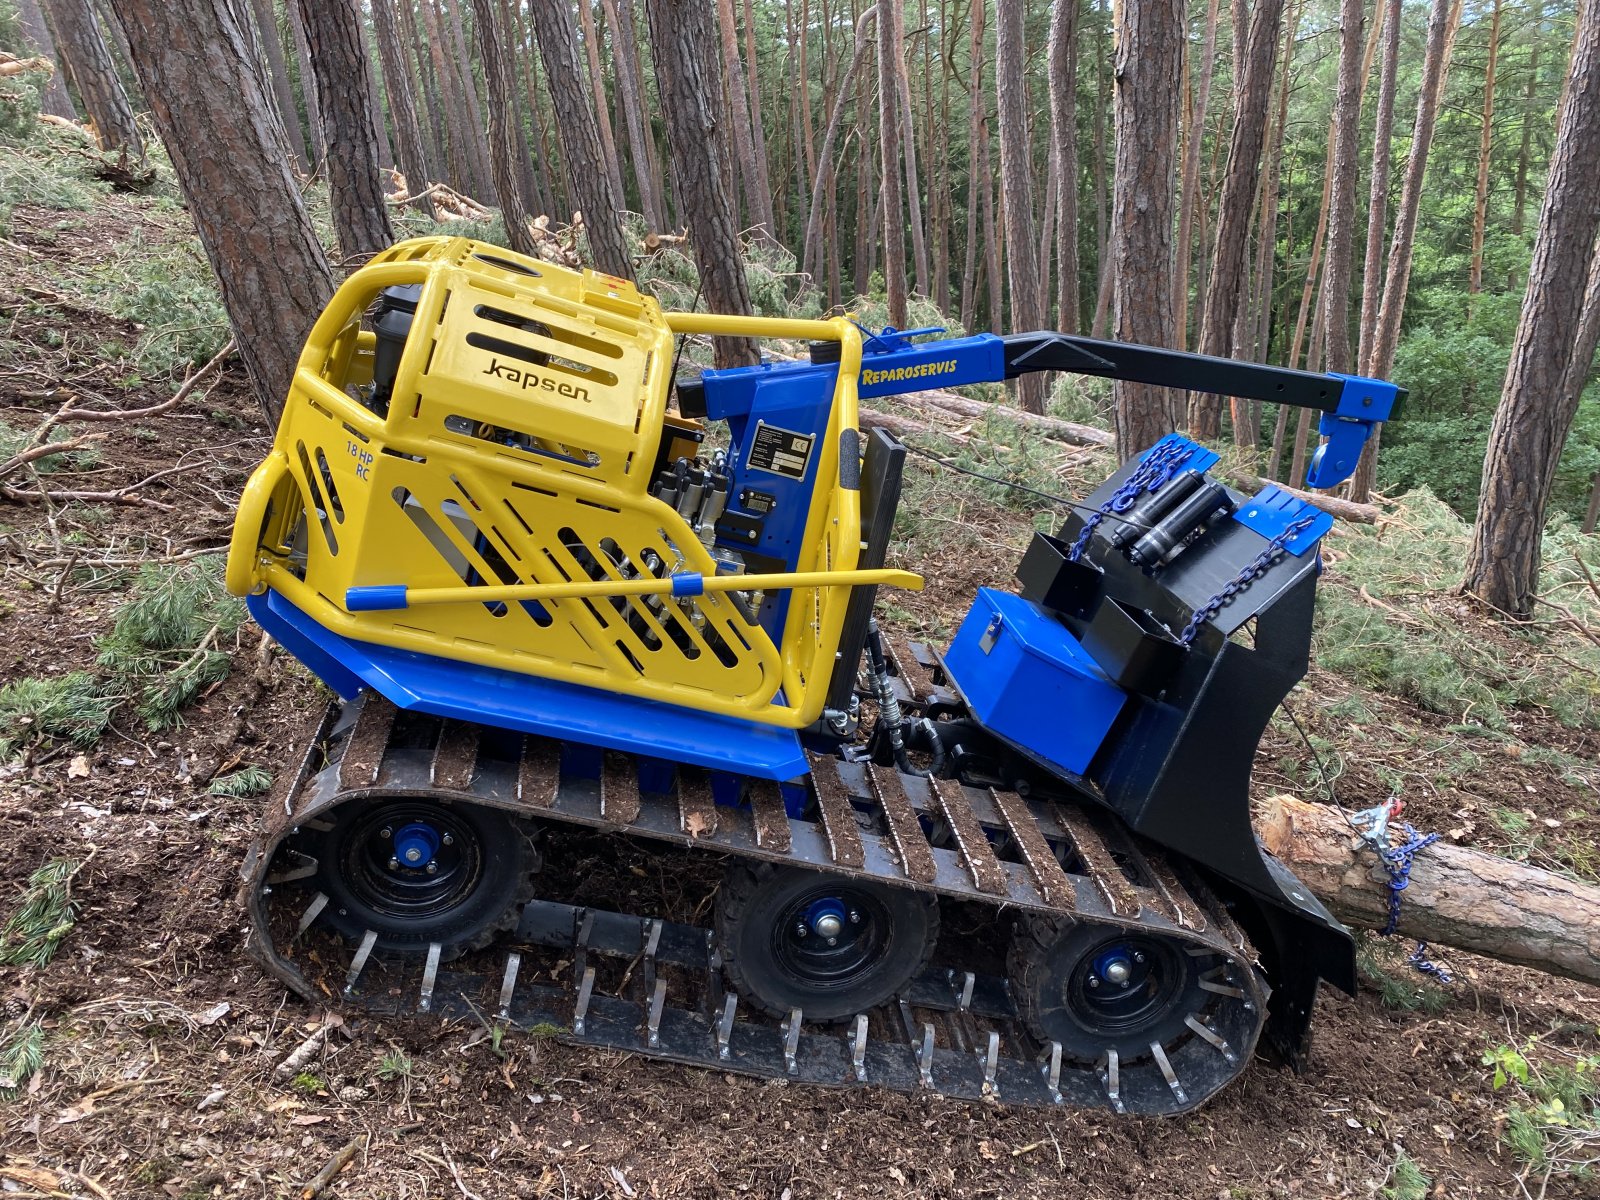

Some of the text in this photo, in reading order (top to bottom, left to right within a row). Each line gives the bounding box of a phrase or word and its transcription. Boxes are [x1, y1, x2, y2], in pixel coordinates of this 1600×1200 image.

[482, 358, 592, 403] kapsen
[862, 360, 957, 386] REPAROSERVIS
[347, 440, 374, 466] 18 HP
[794, 441, 806, 451] CE
[356, 463, 370, 482] RC
